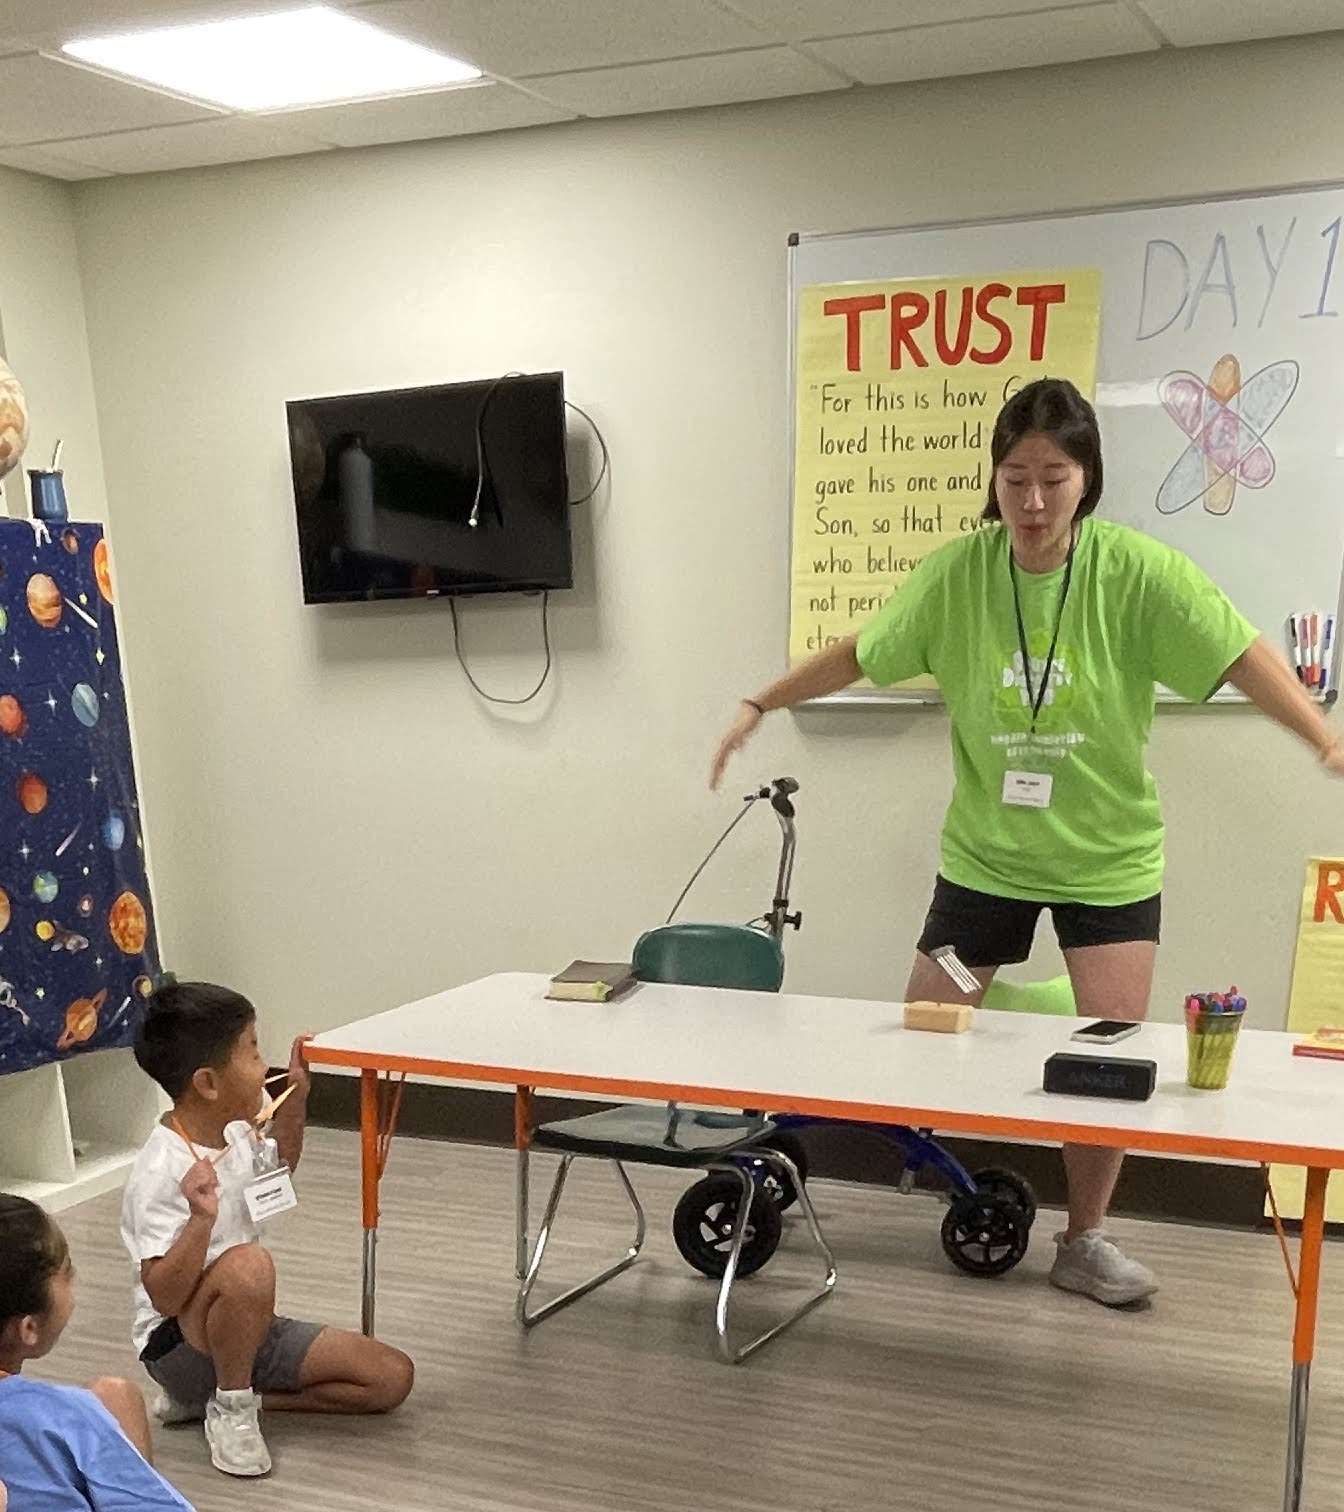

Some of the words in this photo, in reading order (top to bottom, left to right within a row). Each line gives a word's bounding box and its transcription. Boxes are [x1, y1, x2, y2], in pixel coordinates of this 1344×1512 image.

[1135, 216, 1297, 341] DAY
[1298, 216, 1342, 319] 1
[823, 283, 1066, 372] TRUST
[864, 382, 905, 412] this
[914, 390, 930, 409] is
[943, 378, 988, 408] how
[819, 426, 868, 455] loved
[879, 424, 915, 453] the
[815, 477, 855, 505] gave
[868, 466, 896, 494] his
[906, 474, 938, 492] one
[946, 461, 982, 492] and
[814, 505, 859, 538] Son,
[871, 516, 891, 534] so
[900, 503, 943, 534] that
[812, 545, 853, 574] who
[867, 545, 922, 574] believ
[808, 585, 836, 612] not
